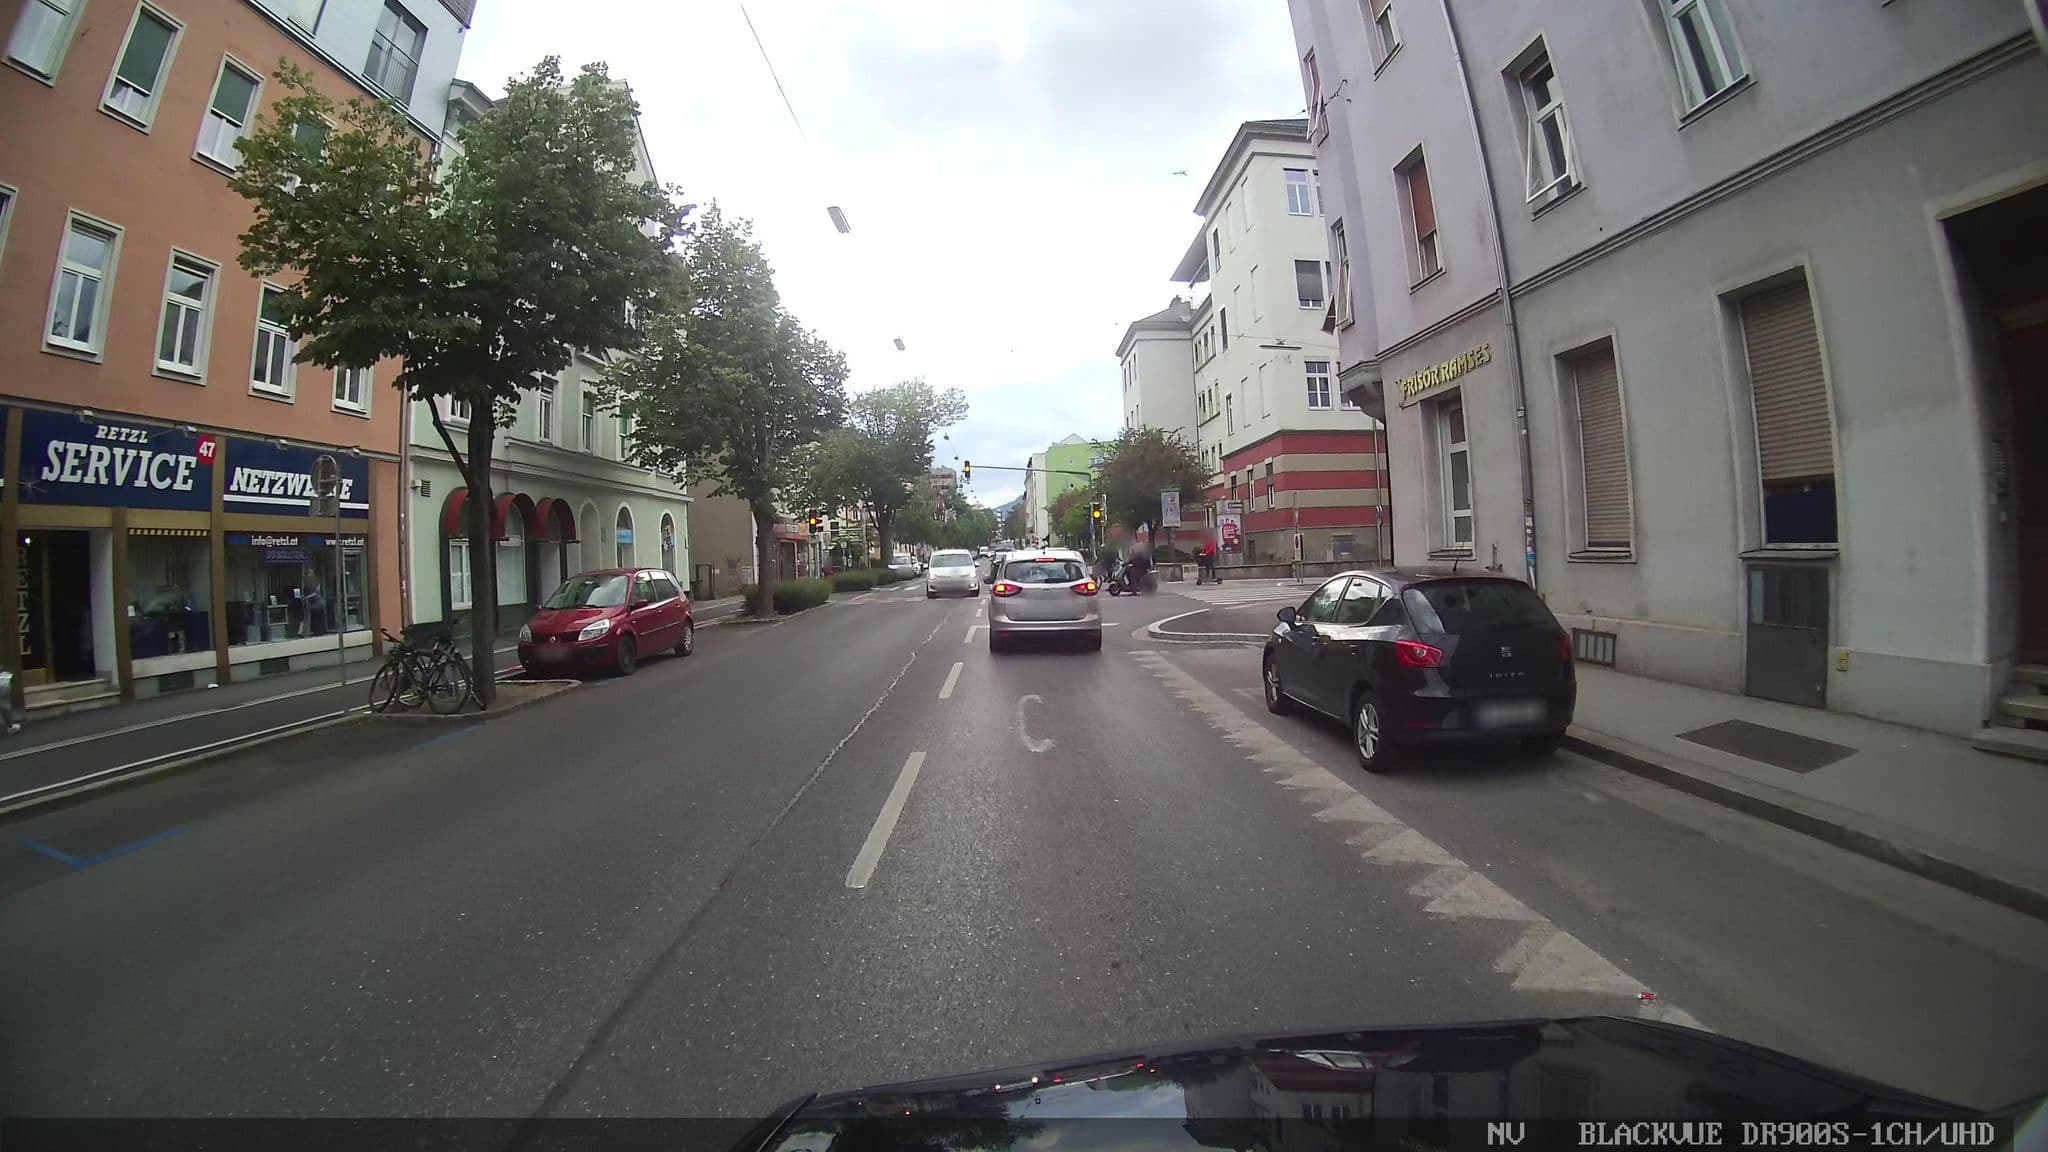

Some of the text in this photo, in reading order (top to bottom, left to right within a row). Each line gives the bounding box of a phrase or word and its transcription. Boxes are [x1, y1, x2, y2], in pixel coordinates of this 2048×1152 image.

[1400, 341, 1491, 401] FRISÖR RAMSES
[95, 425, 148, 444] RETZL
[198, 441, 216, 458] 47
[41, 440, 198, 491] SERVICE
[251, 535, 298, 548] info@retzl.at
